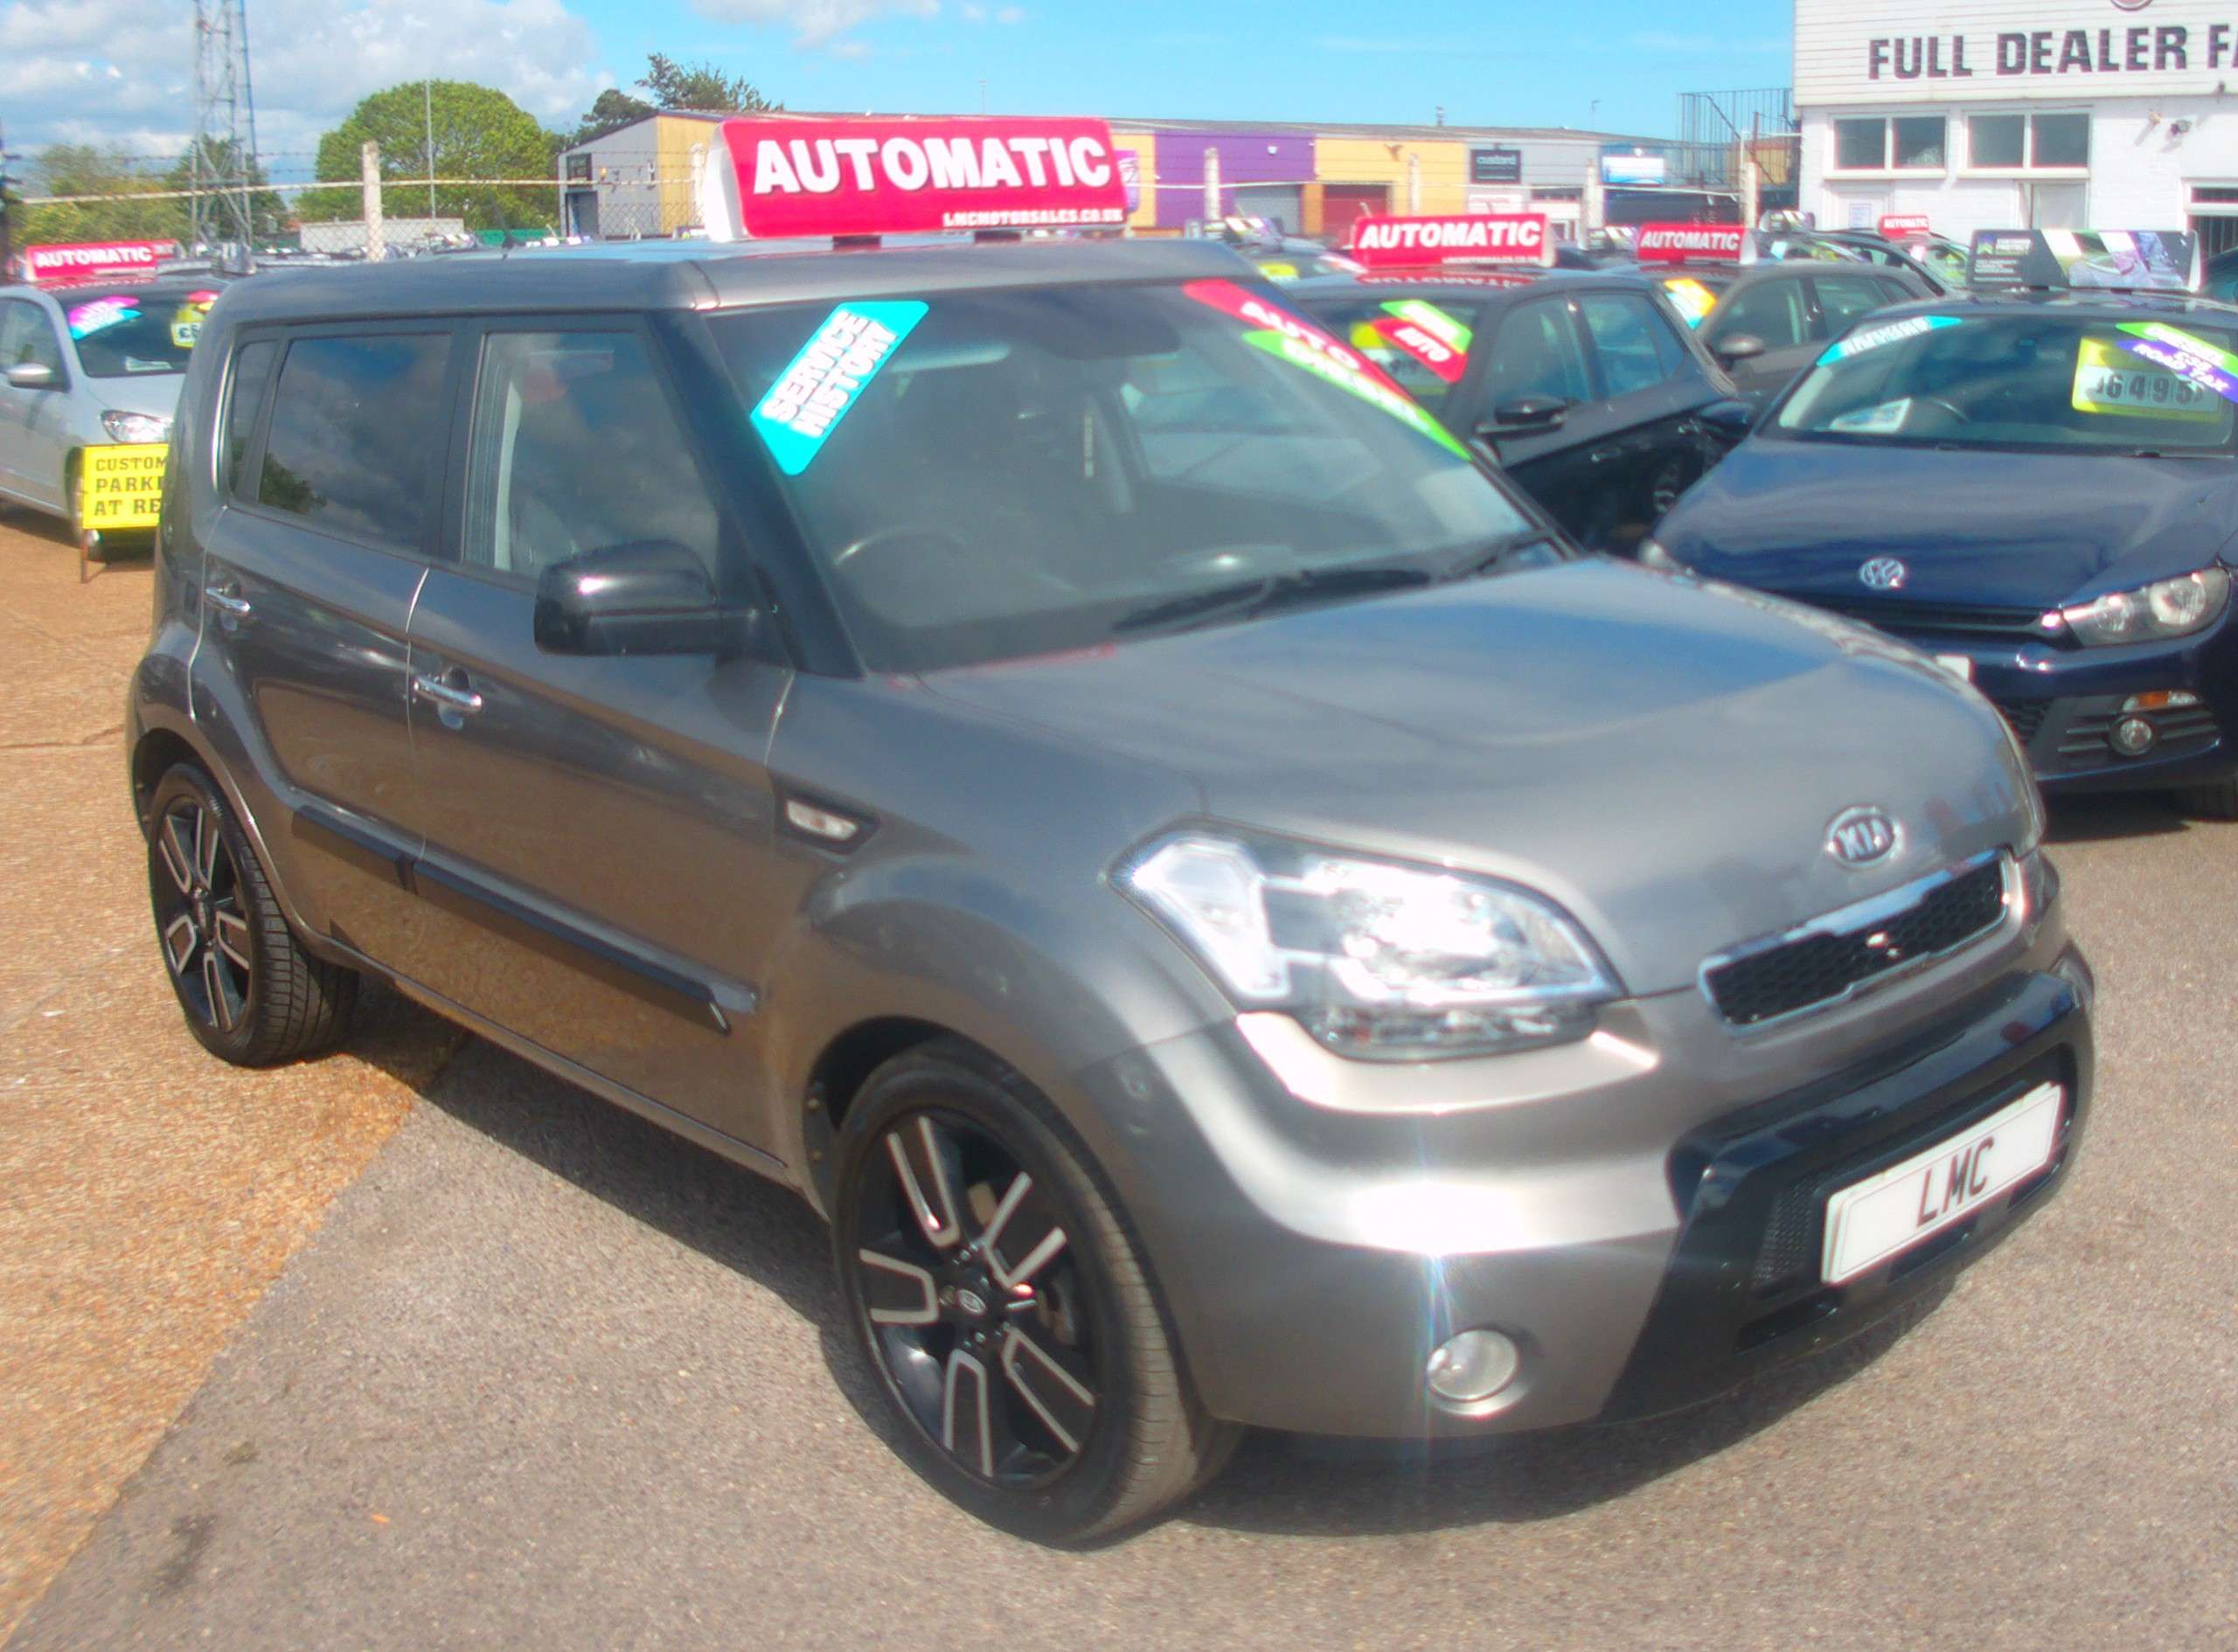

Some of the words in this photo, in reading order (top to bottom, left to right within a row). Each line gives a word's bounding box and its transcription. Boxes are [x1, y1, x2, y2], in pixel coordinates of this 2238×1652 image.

[1868, 35, 1973, 80] FULL
[1995, 25, 2188, 76] DEALER
[2207, 24, 2238, 70] F
[754, 136, 1110, 195] AUTOMATIC
[33, 246, 154, 268] AUTOMATIC
[1358, 220, 1541, 249] AUTOMATIC
[1640, 231, 1741, 251] AUTOMATIC
[761, 309, 872, 423] SERVICE
[789, 321, 899, 439] HISTORY
[94, 499, 123, 516] AT
[1915, 1135, 1995, 1228] LMC
